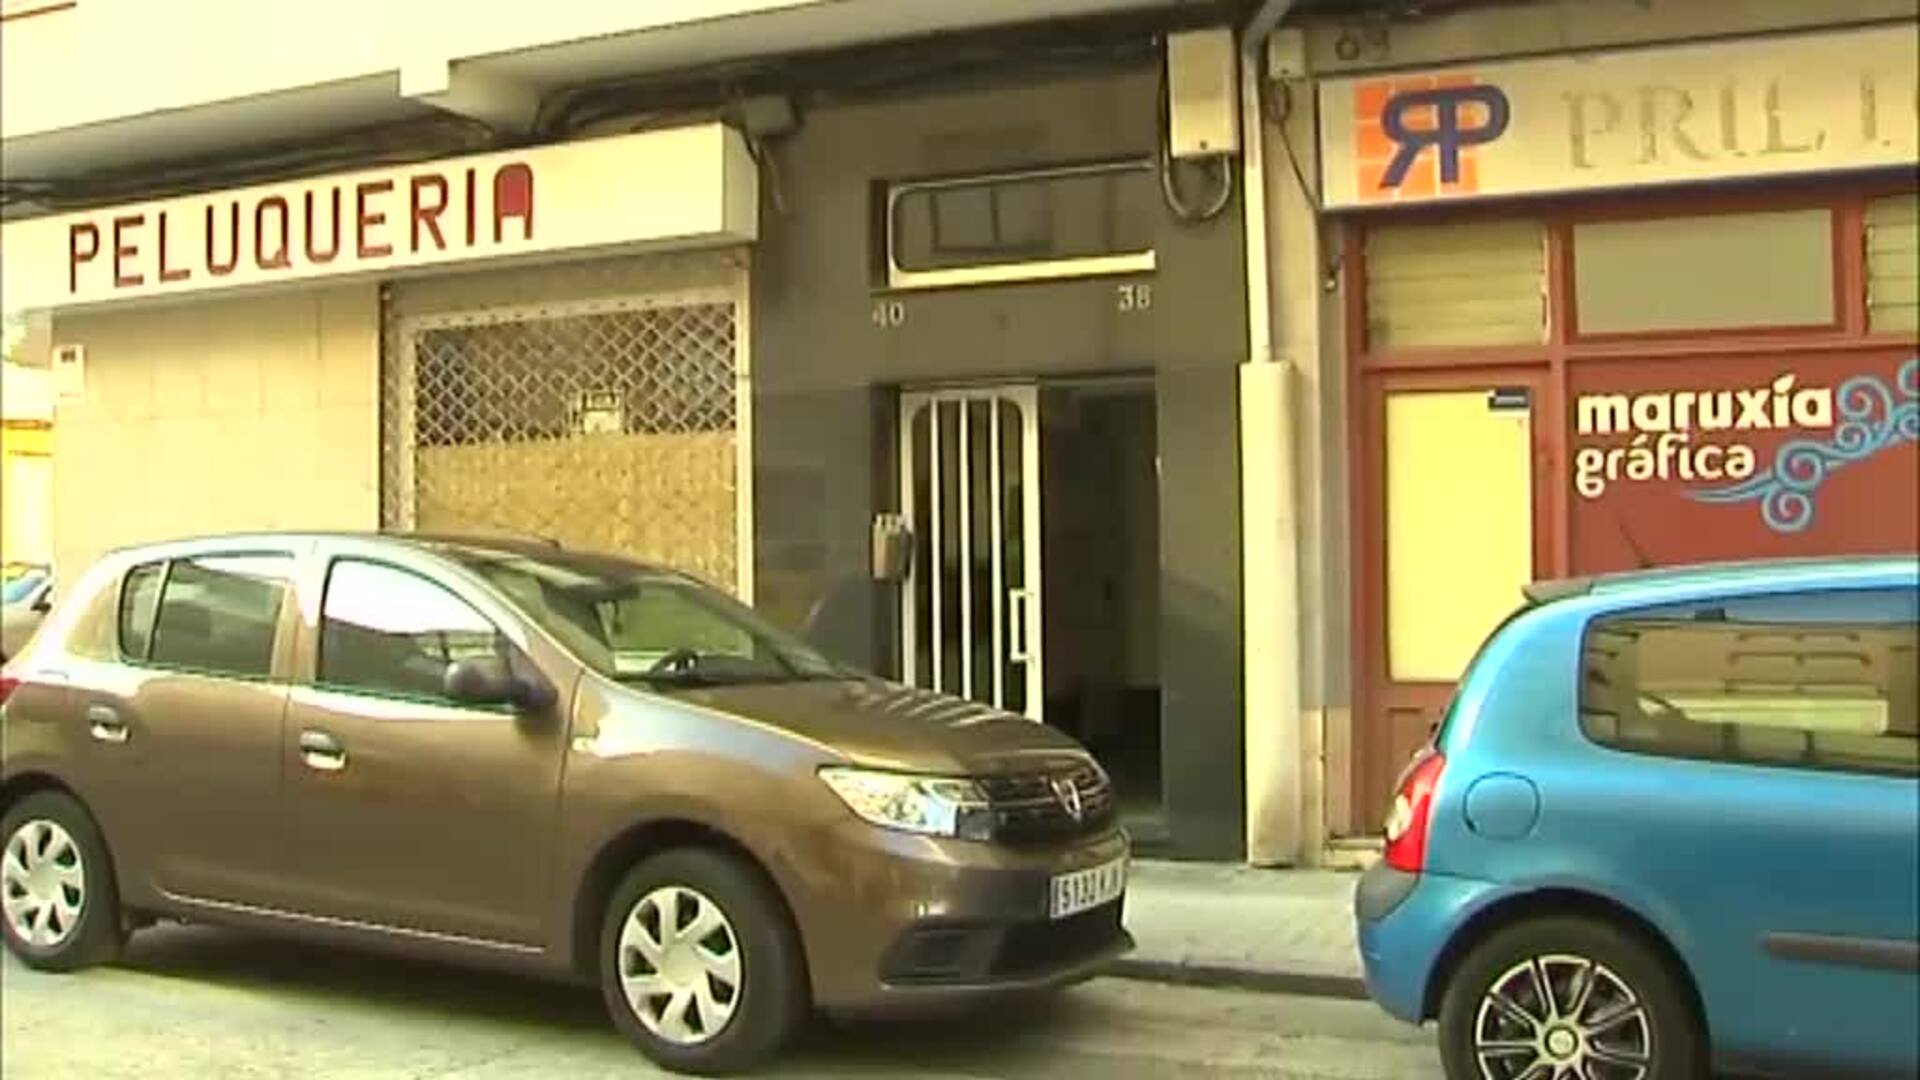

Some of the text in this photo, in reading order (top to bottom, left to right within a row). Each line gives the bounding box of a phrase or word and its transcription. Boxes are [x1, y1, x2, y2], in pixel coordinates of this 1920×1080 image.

[69, 162, 534, 293] PELUQUERIA
[1577, 374, 1833, 435] maruxía
[1576, 431, 1756, 498] gráfica
